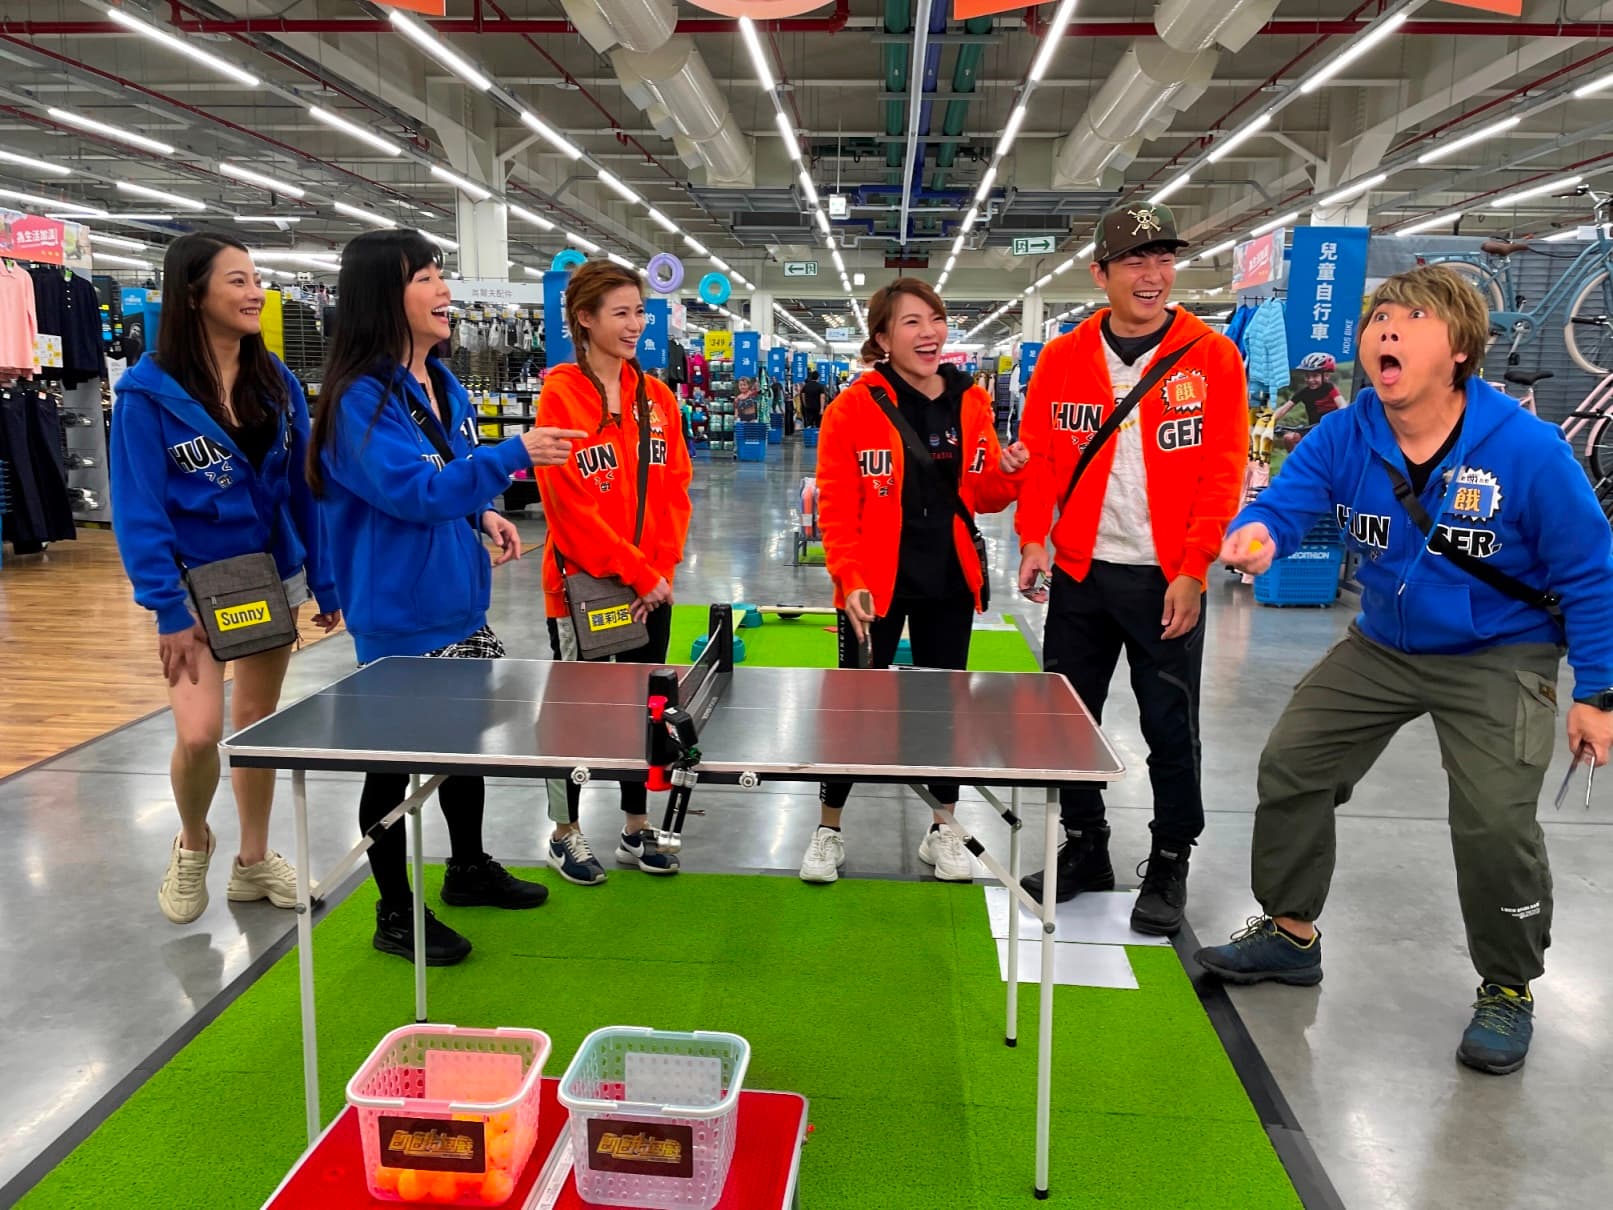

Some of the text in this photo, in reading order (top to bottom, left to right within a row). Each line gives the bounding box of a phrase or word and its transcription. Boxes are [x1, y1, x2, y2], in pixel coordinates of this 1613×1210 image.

[1310, 242, 1338, 341] 兒童自行車
[1342, 319, 1354, 354] KIDS BIKE
[1051, 401, 1105, 433] HUN
[575, 442, 619, 479] HUN
[1454, 487, 1481, 512] 餓
[1336, 503, 1391, 549] HUN
[220, 607, 265, 626] Sunny
